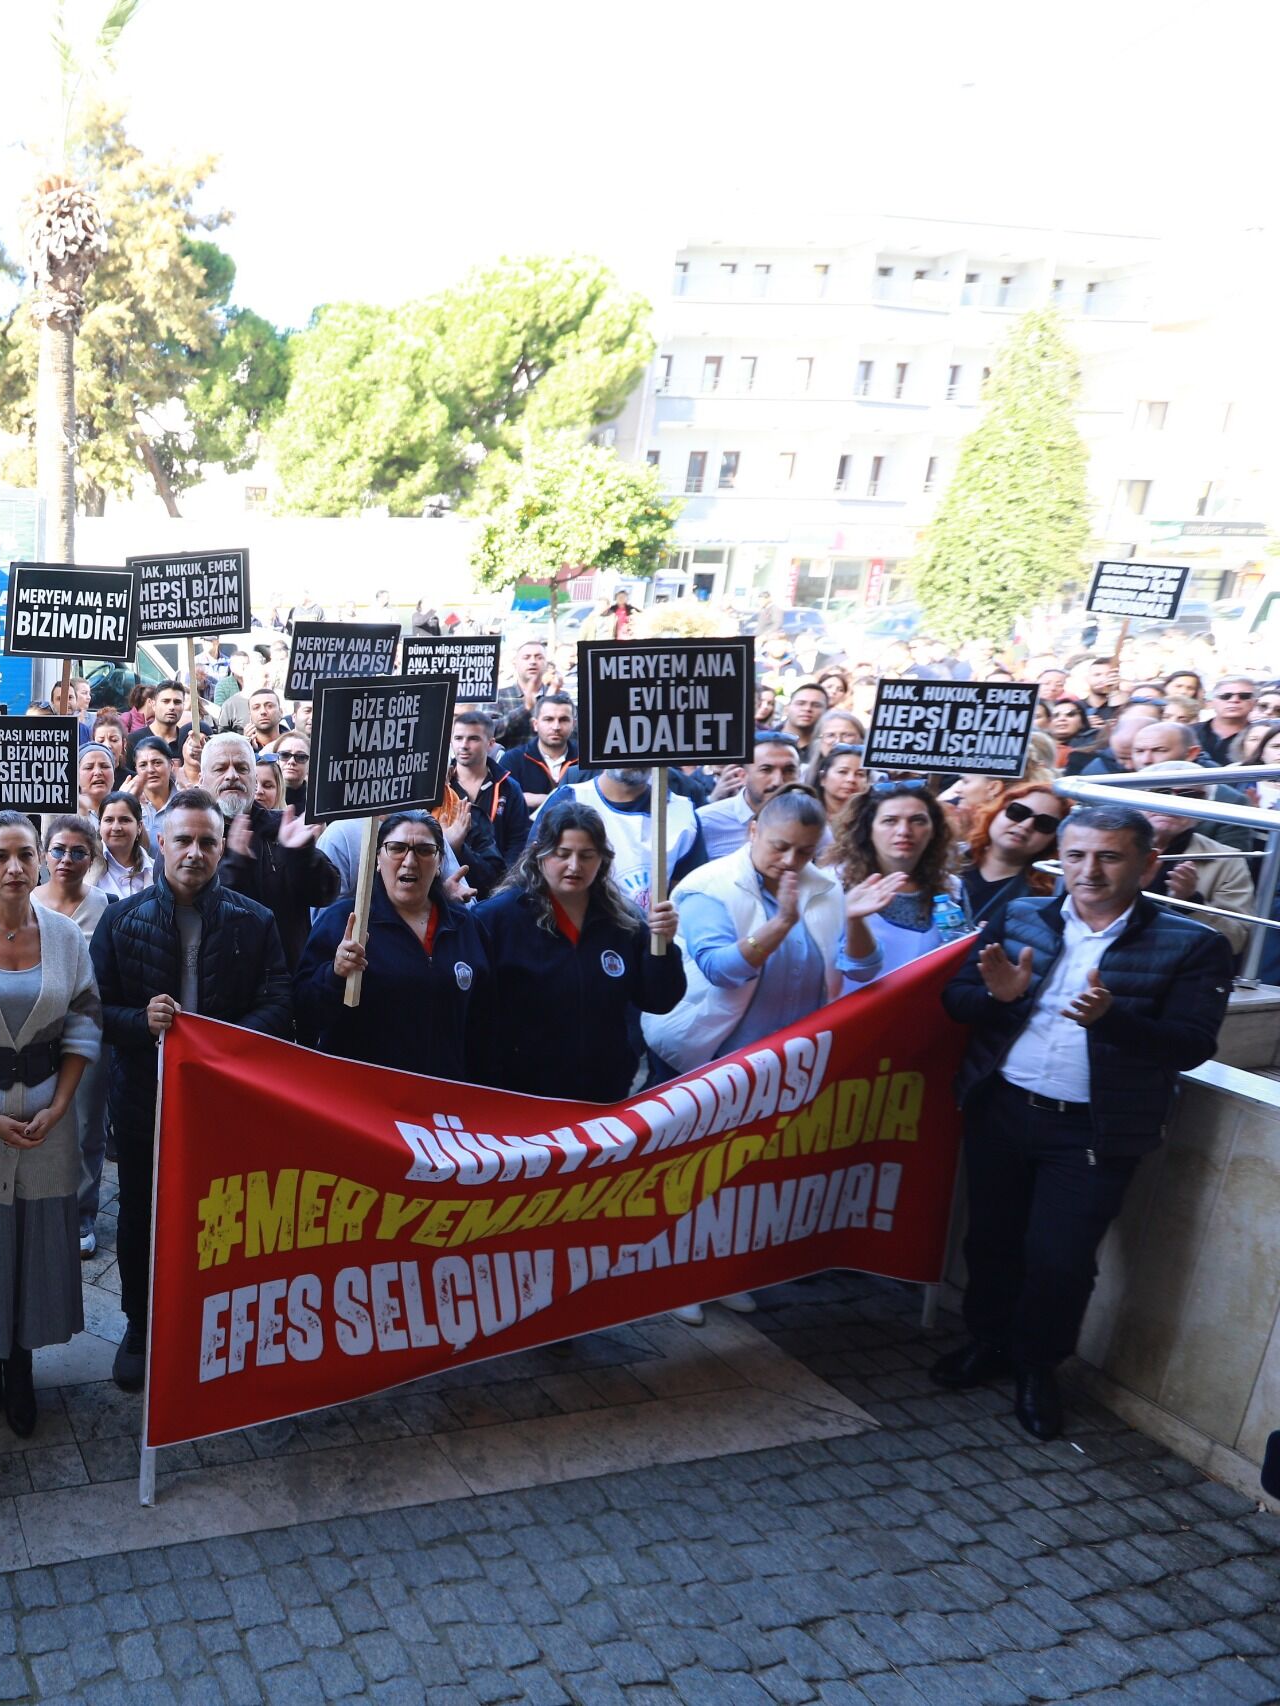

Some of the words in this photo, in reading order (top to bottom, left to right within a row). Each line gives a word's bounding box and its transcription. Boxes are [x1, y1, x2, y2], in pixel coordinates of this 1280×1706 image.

[166, 563, 205, 576] HUKUK,
[208, 559, 237, 573] EMEK
[19, 588, 71, 605] MERYEM
[75, 590, 102, 607] ANA
[106, 589, 128, 609] EVİ
[140, 577, 186, 601] HEPSİ
[192, 574, 238, 597] BİZİM
[140, 599, 180, 620] HEPSİ
[186, 595, 238, 617] İŞÇİNİN
[16, 605, 125, 641] BİZİMDİR!
[142, 614, 238, 631] #MERYEMANAEVİBİZİMDİR
[297, 637, 345, 651] MERYEM
[347, 638, 371, 652] ANA
[375, 636, 394, 653] EVİ
[408, 644, 433, 655] DÜNYA
[435, 644, 462, 654] MİRASI
[464, 645, 495, 654] MERYEM
[293, 653, 336, 670] RANT
[338, 654, 391, 672] KAPISI
[408, 657, 428, 668] ANA
[432, 655, 447, 668] EVİ
[450, 654, 494, 667] BİZİMDİR
[599, 654, 687, 680] MERYEM
[694, 653, 736, 677] ANA
[351, 692, 384, 720] BİZE
[388, 691, 421, 717] GÖRE
[629, 680, 662, 711] EVİ
[670, 679, 709, 712] İÇİN
[882, 685, 919, 701] HAK,
[923, 686, 982, 704] HUKUK,
[985, 689, 1033, 704] EMEK
[876, 703, 951, 729] HEPSİ
[956, 705, 1029, 733] BİZİM
[26, 730, 69, 742] MERYEM
[348, 717, 419, 753] MABET
[603, 713, 733, 754] ADALET
[872, 729, 936, 751] HEPSİ
[940, 729, 1024, 756] İŞÇİNİN
[7, 741, 69, 761] BİZİMDİR
[328, 754, 395, 782] İKTİDARA
[397, 750, 430, 774] GÖRE
[343, 776, 412, 806] MARKET!
[394, 1113, 637, 1185] DÜNYA
[625, 1030, 833, 1156] MİRASI
[199, 1274, 322, 1383] EFES
